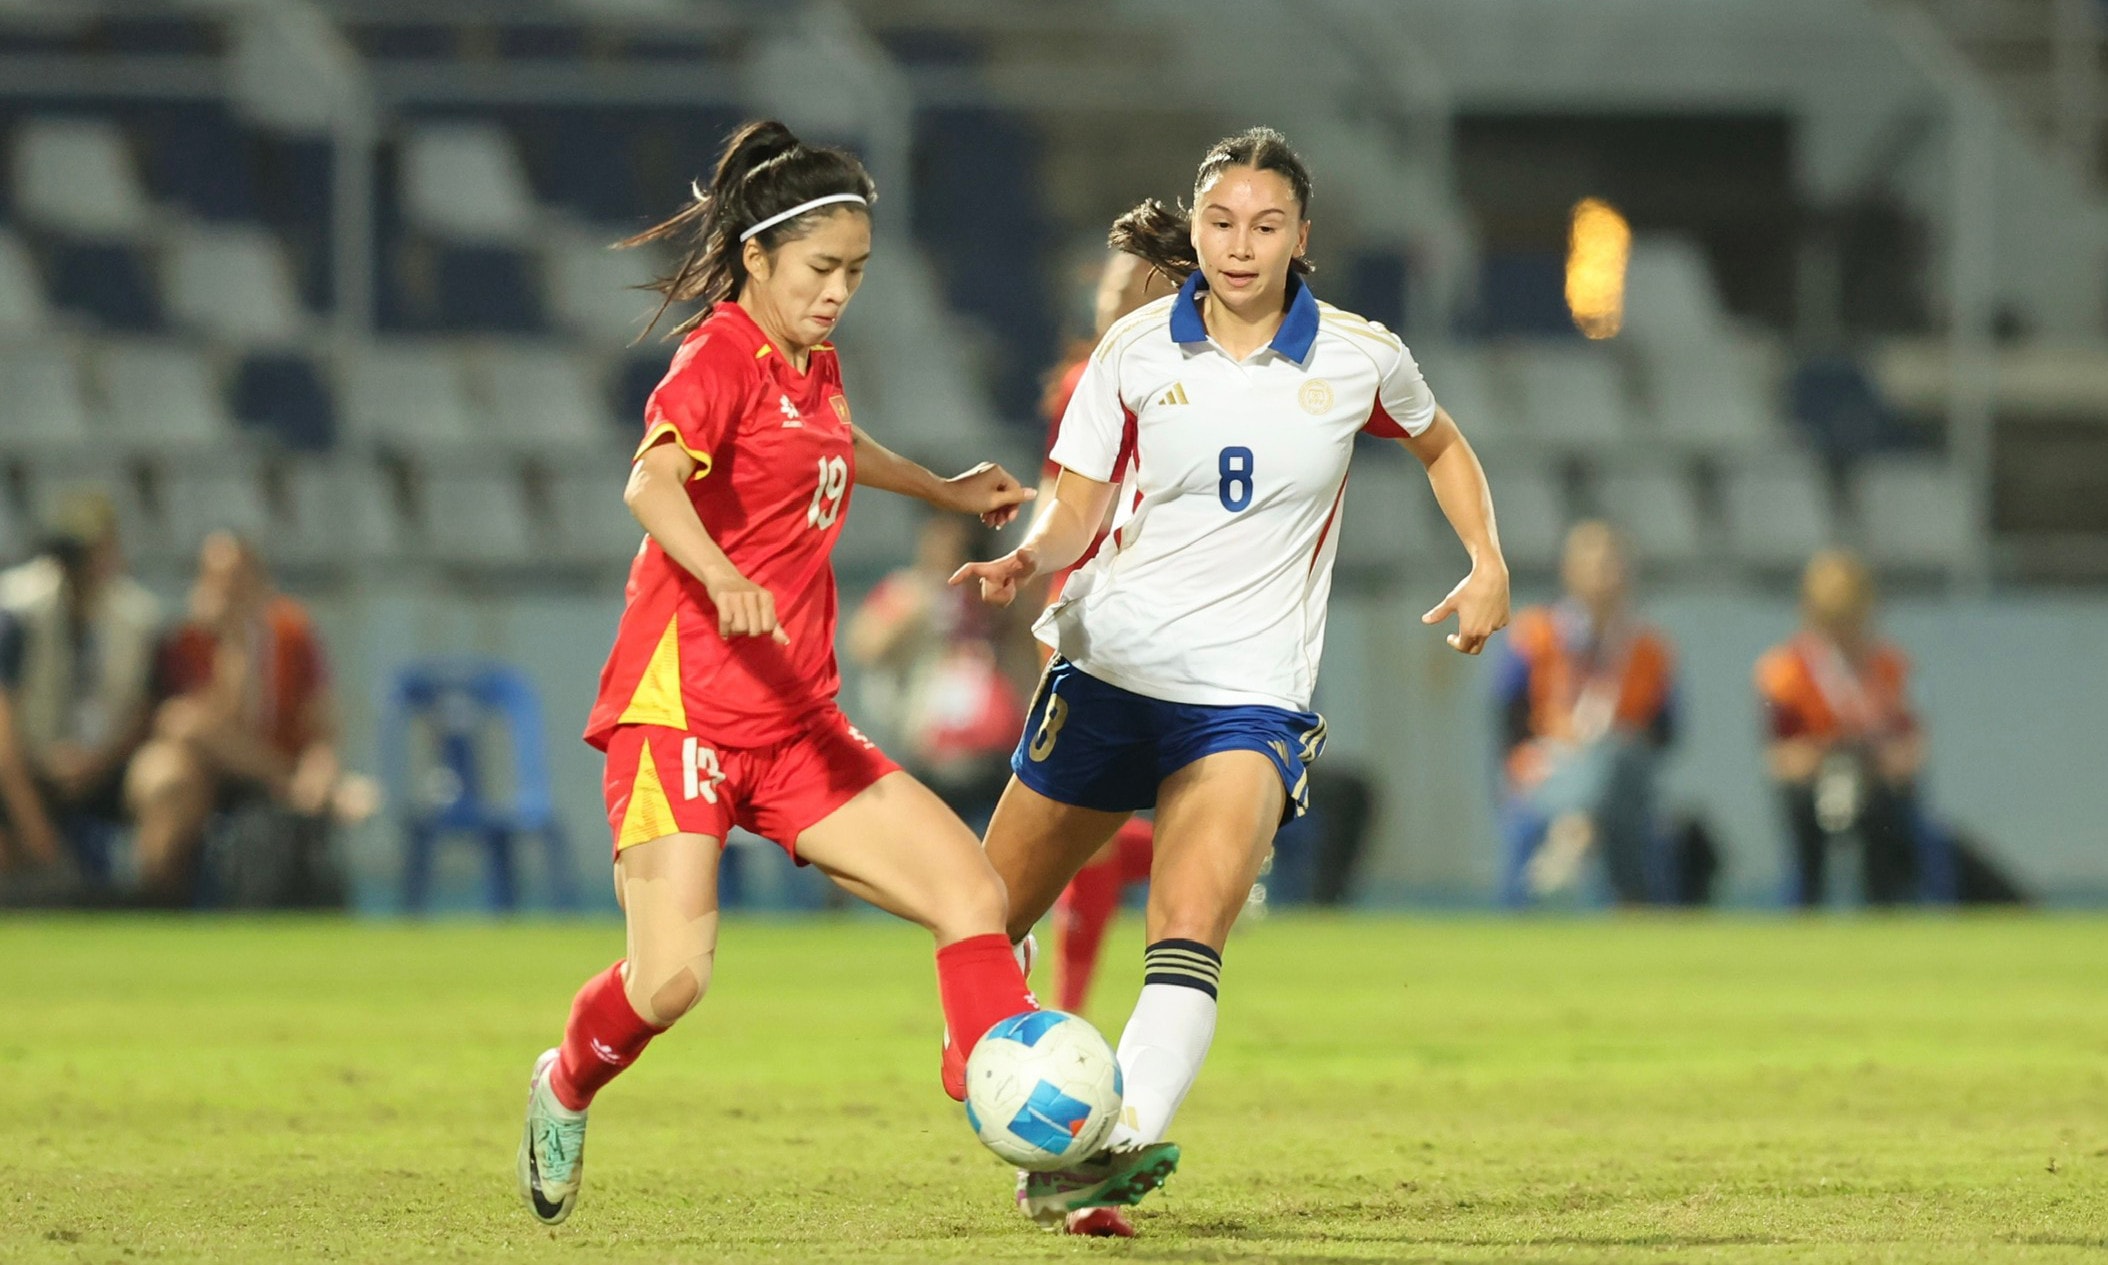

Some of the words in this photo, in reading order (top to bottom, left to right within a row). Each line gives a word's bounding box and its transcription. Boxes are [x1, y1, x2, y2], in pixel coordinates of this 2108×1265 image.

[807, 455, 848, 531] 19
[1219, 446, 1254, 513] 8
[1028, 693, 1069, 763] 8
